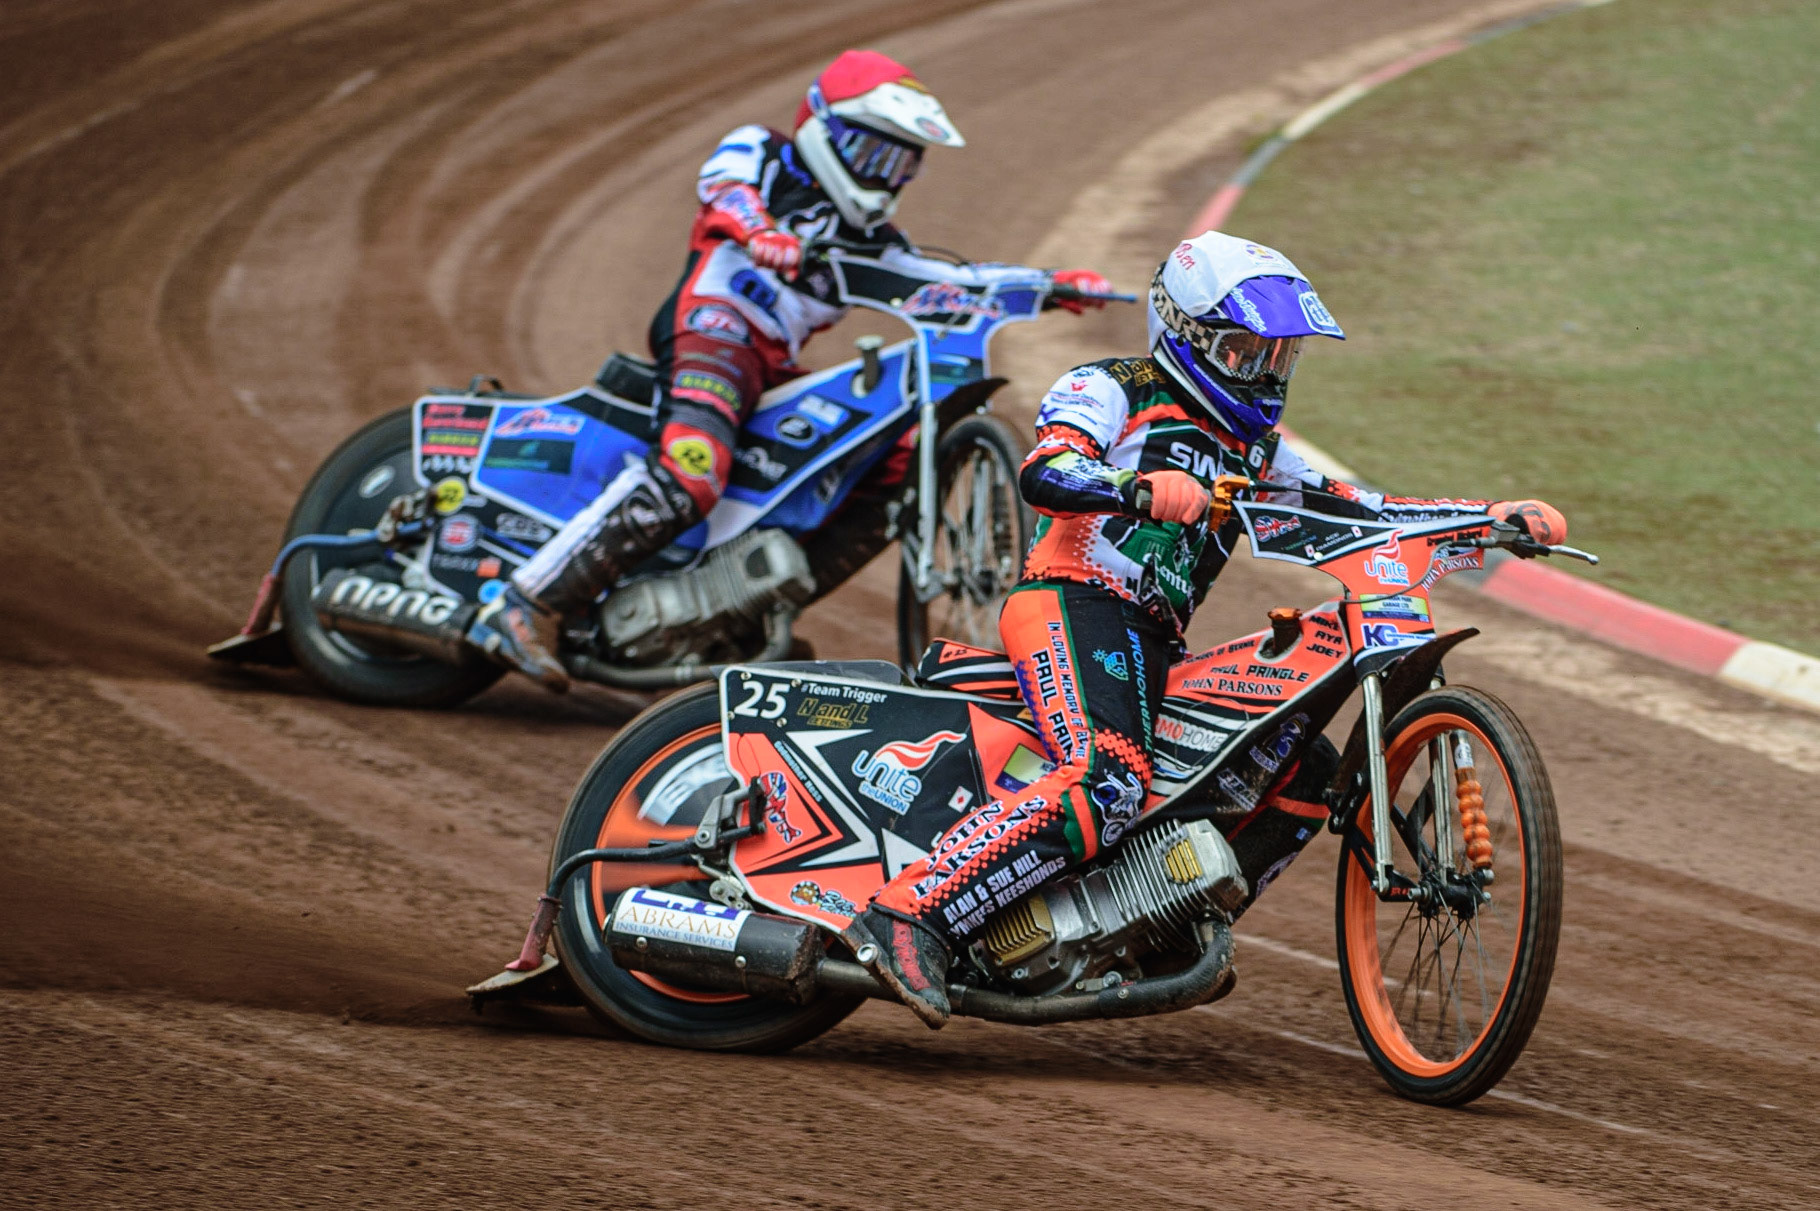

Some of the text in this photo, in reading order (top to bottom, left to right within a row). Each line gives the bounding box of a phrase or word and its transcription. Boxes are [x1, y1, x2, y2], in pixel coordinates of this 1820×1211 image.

[1048, 622, 1062, 632] IN
[1051, 635, 1070, 670] LOVING
[1306, 643, 1344, 658] JOEY
[1032, 649, 1058, 708] PAUL
[1218, 679, 1283, 697] PARSONS
[1245, 665, 1310, 682] PRINGLE
[733, 680, 790, 720] 25
[797, 698, 871, 724] N and L
[843, 686, 888, 703] Trigger
[1060, 674, 1080, 715] MEMORY
[852, 751, 920, 801] unite
[912, 795, 1047, 900] PARSONS
[943, 850, 1042, 925] ALAN & SUE HILL
[994, 856, 1067, 908] KEESHONDS
[616, 922, 734, 950] INSURANCE SERVICES
[620, 906, 738, 939] ABRAMS
